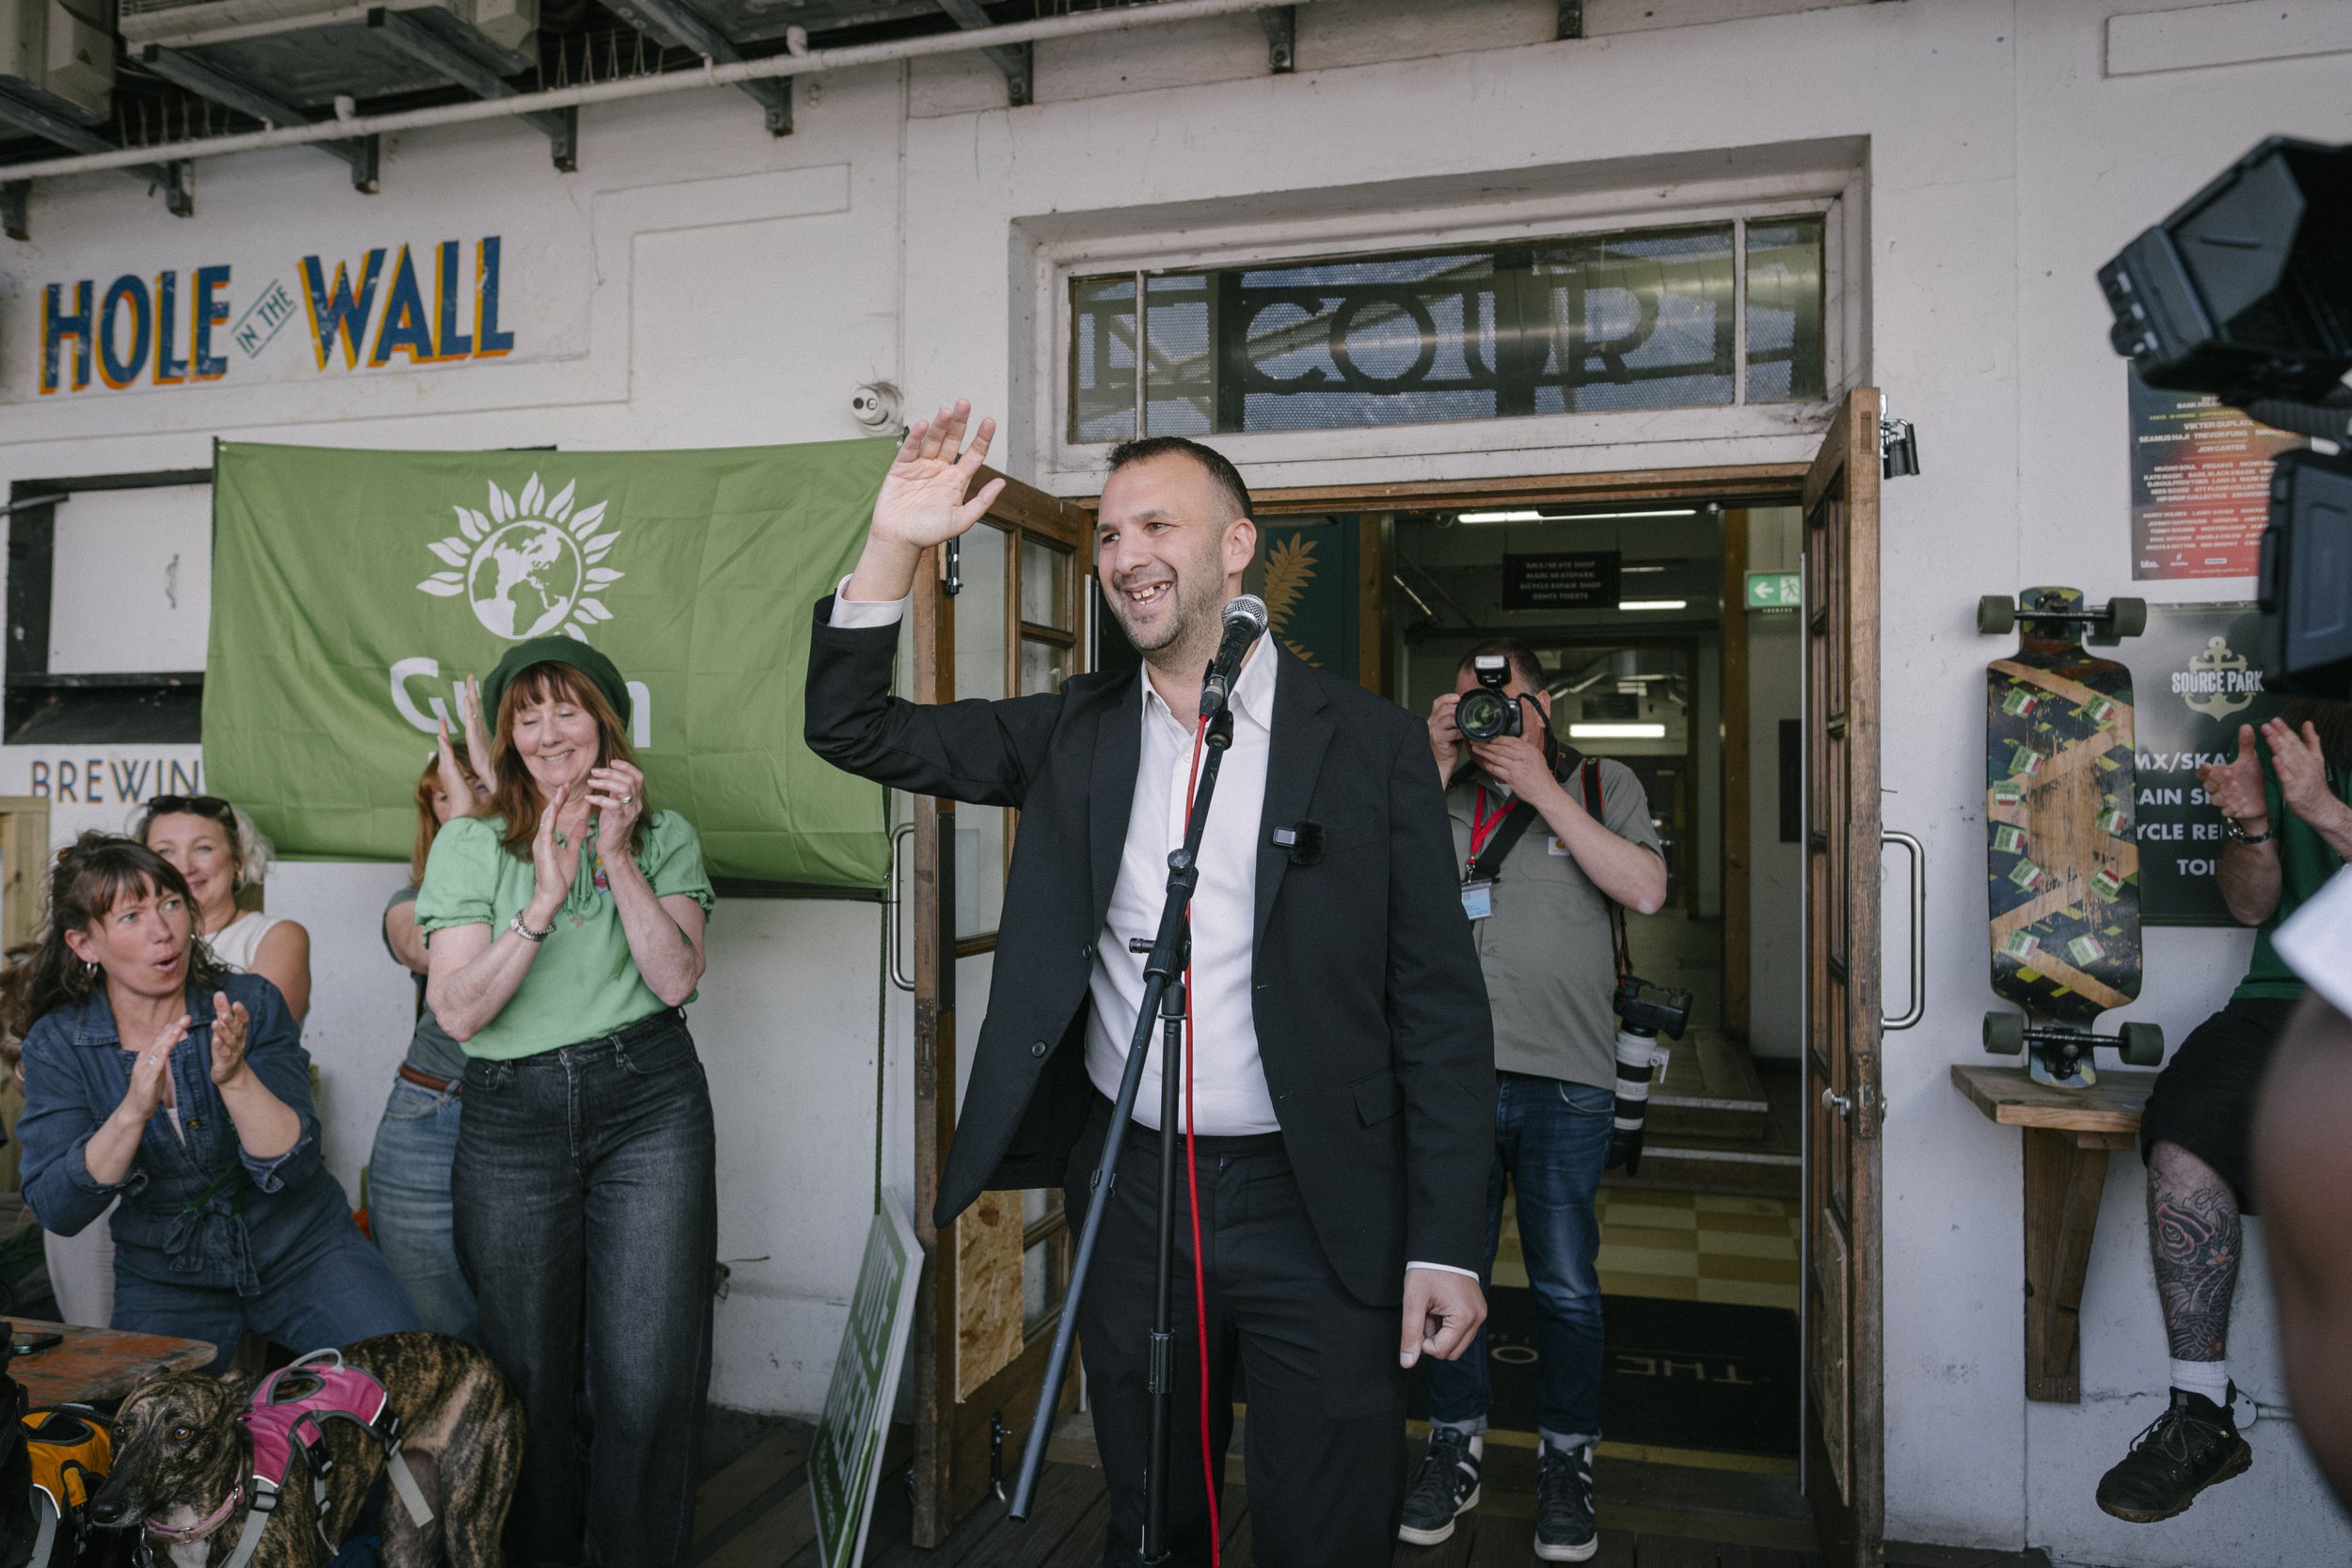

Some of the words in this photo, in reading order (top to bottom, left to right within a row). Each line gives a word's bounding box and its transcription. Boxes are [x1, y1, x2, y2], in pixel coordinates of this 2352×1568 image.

[40, 264, 230, 395] HOLE
[235, 325, 260, 354] IN
[257, 285, 294, 326] THE
[296, 236, 515, 372] WALL
[2171, 671, 2225, 693] SOURCE
[2227, 669, 2265, 692] PARK
[2135, 752, 2229, 773] MX/SKA
[31, 758, 199, 803] BREWIN
[2137, 788, 2183, 805] AIN
[2137, 823, 2184, 841] YCLE
[2176, 858, 2216, 876] TOI
